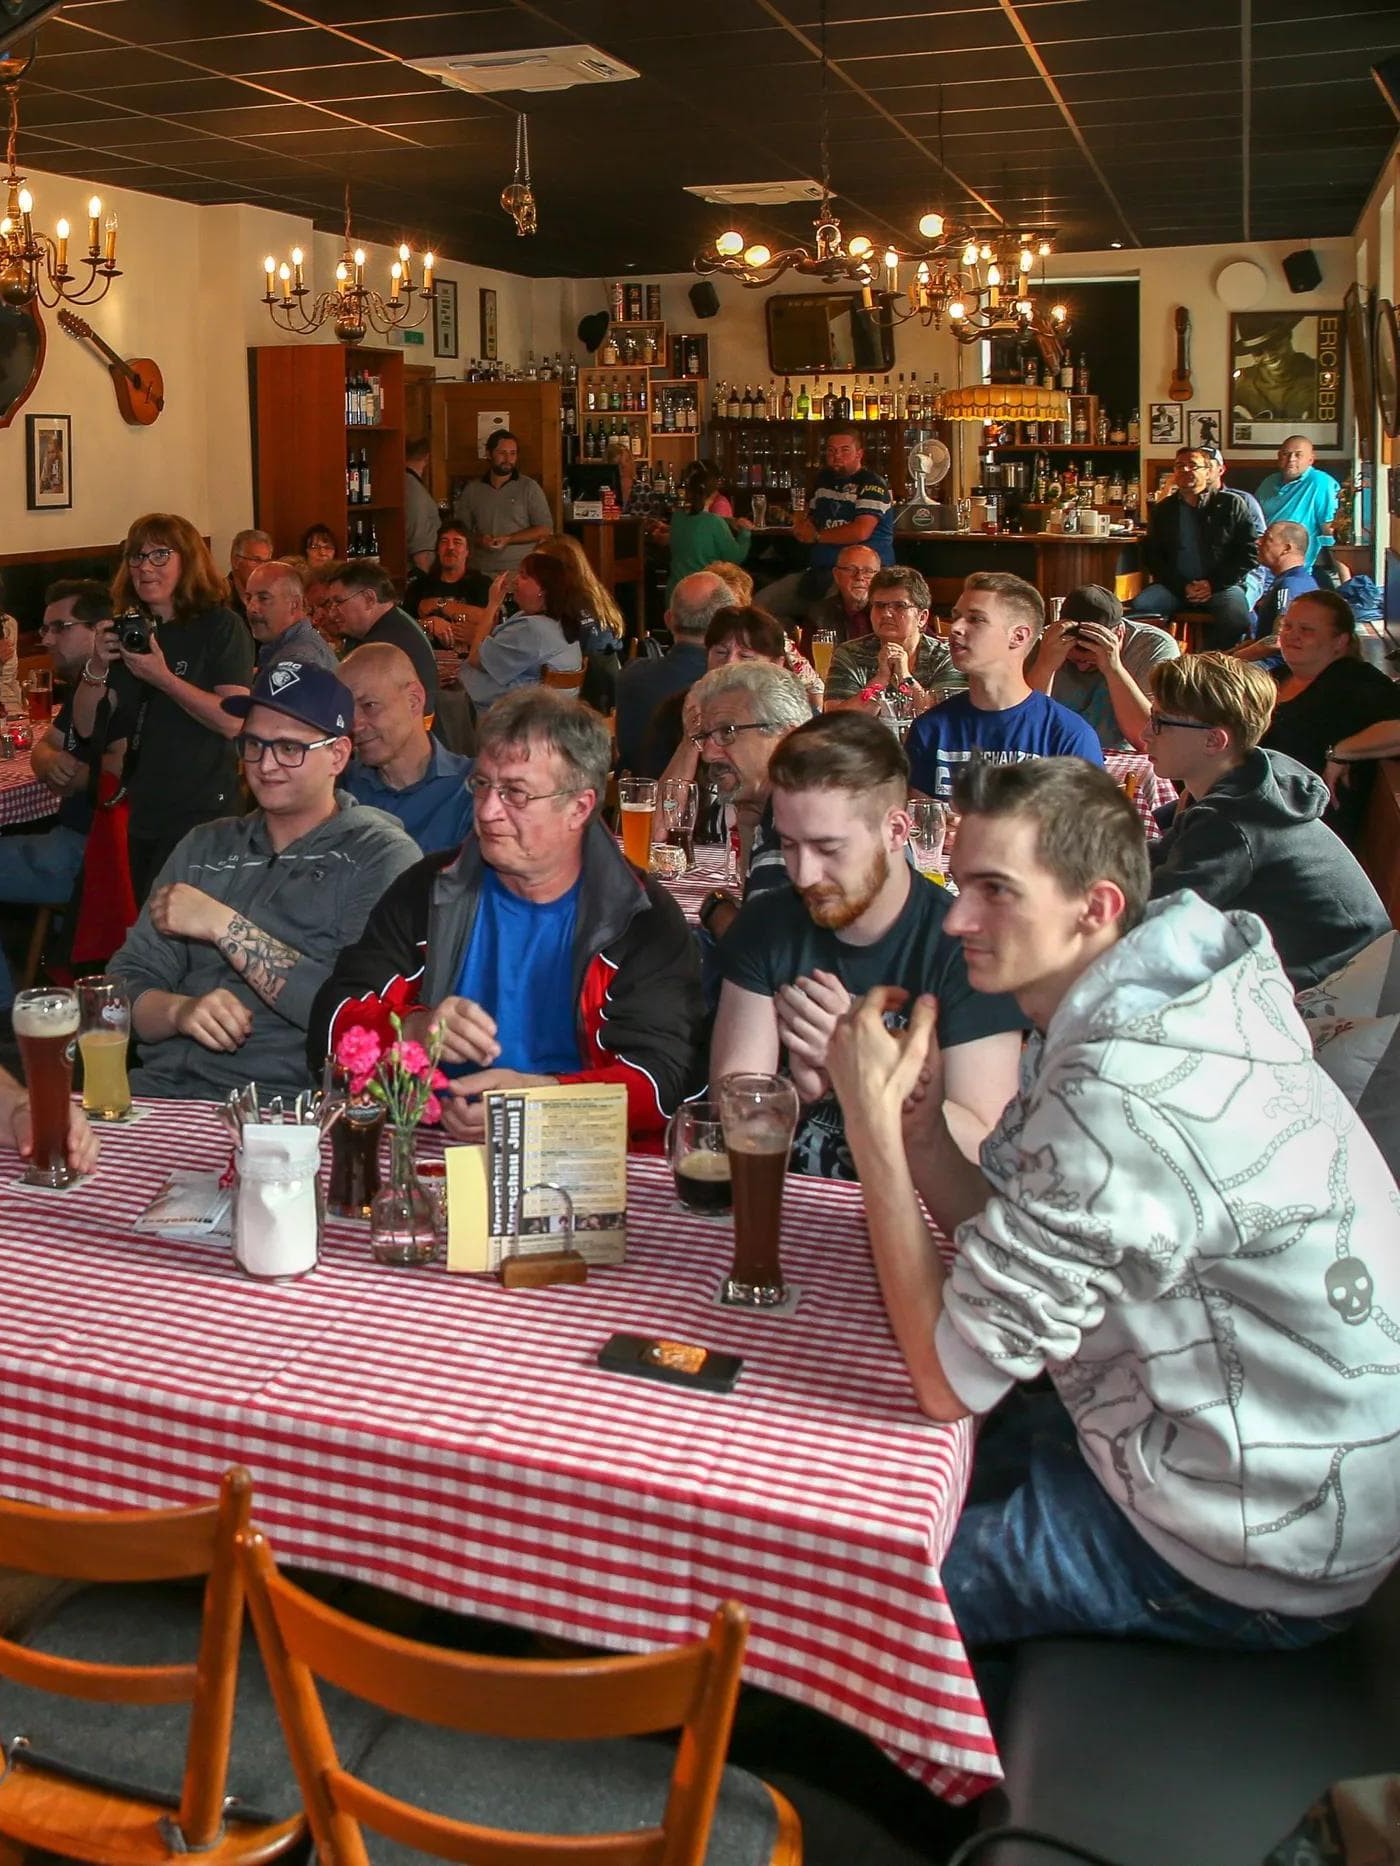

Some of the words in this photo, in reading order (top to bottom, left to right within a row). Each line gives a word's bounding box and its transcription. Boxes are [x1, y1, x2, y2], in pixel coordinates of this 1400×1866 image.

[1319, 317, 1338, 368] ERIC
[1318, 371, 1338, 422] BIBB
[507, 1111, 521, 1149] Juni
[507, 1154, 520, 1234] Vorschau
